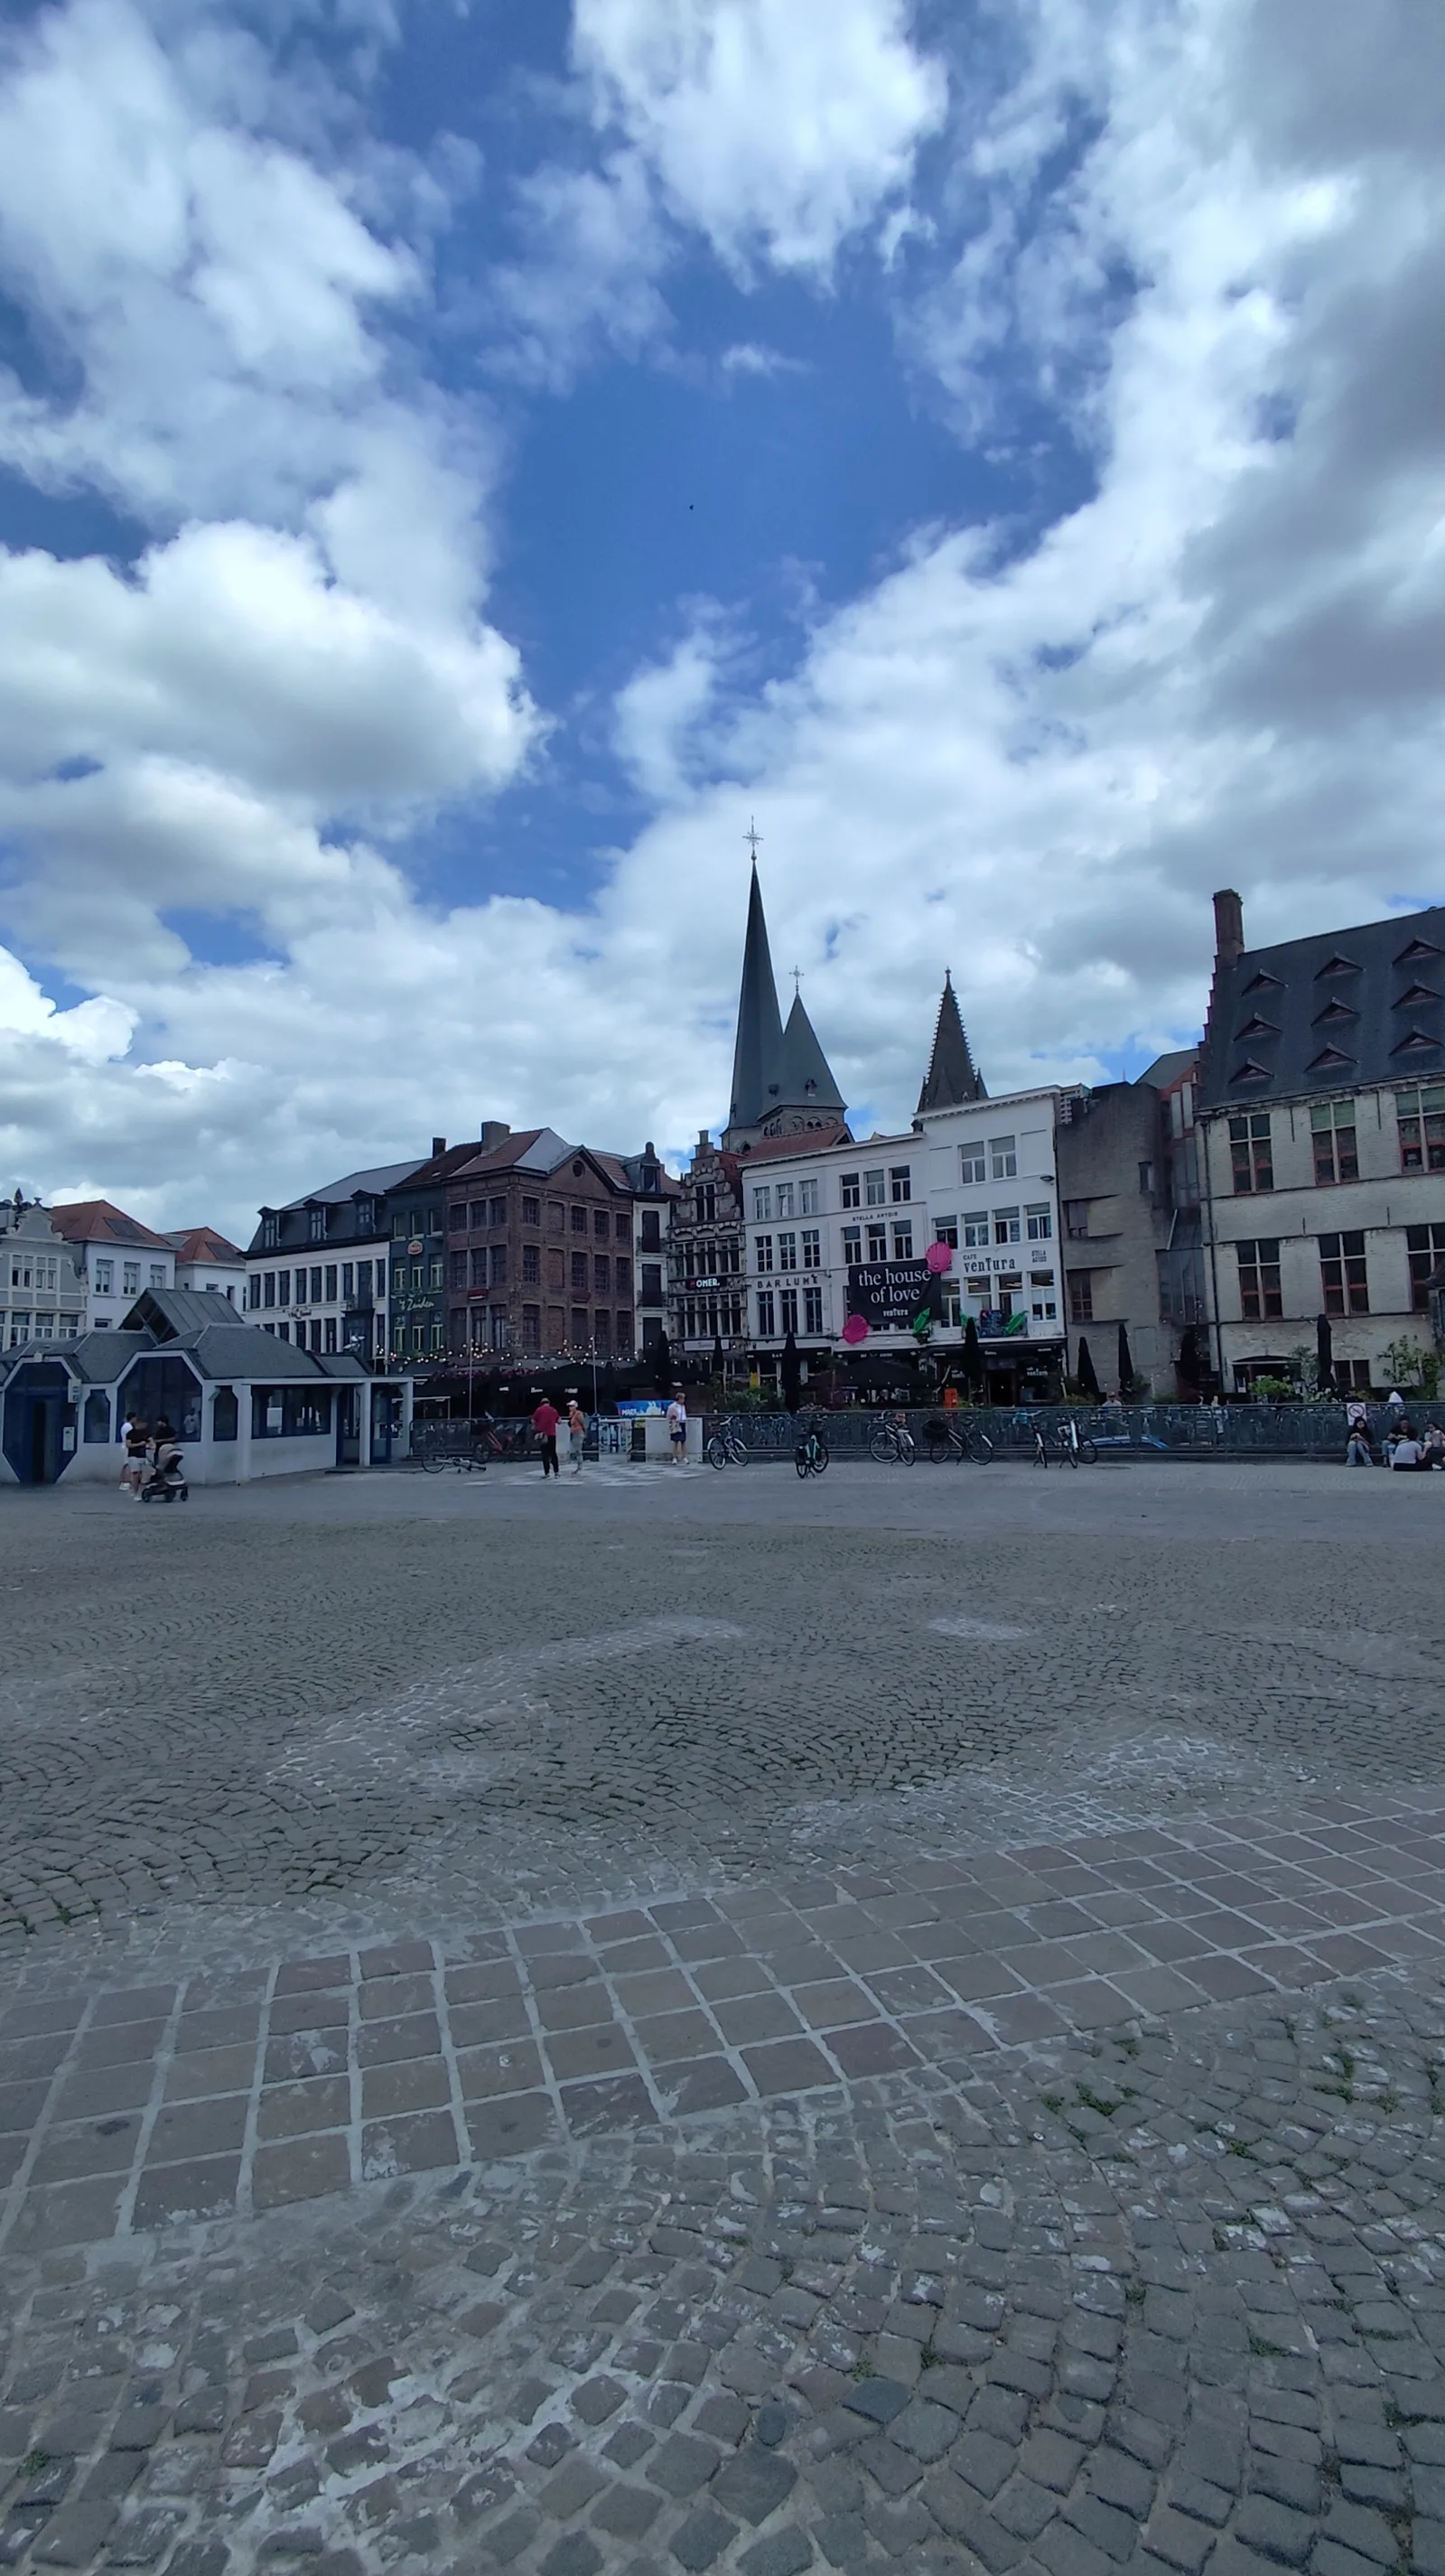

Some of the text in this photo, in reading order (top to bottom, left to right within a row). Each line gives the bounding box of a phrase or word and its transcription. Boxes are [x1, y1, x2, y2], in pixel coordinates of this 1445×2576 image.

[757, 1279, 781, 1289] BAR
[858, 1267, 932, 1286] the house
[870, 1285, 920, 1303] of love
